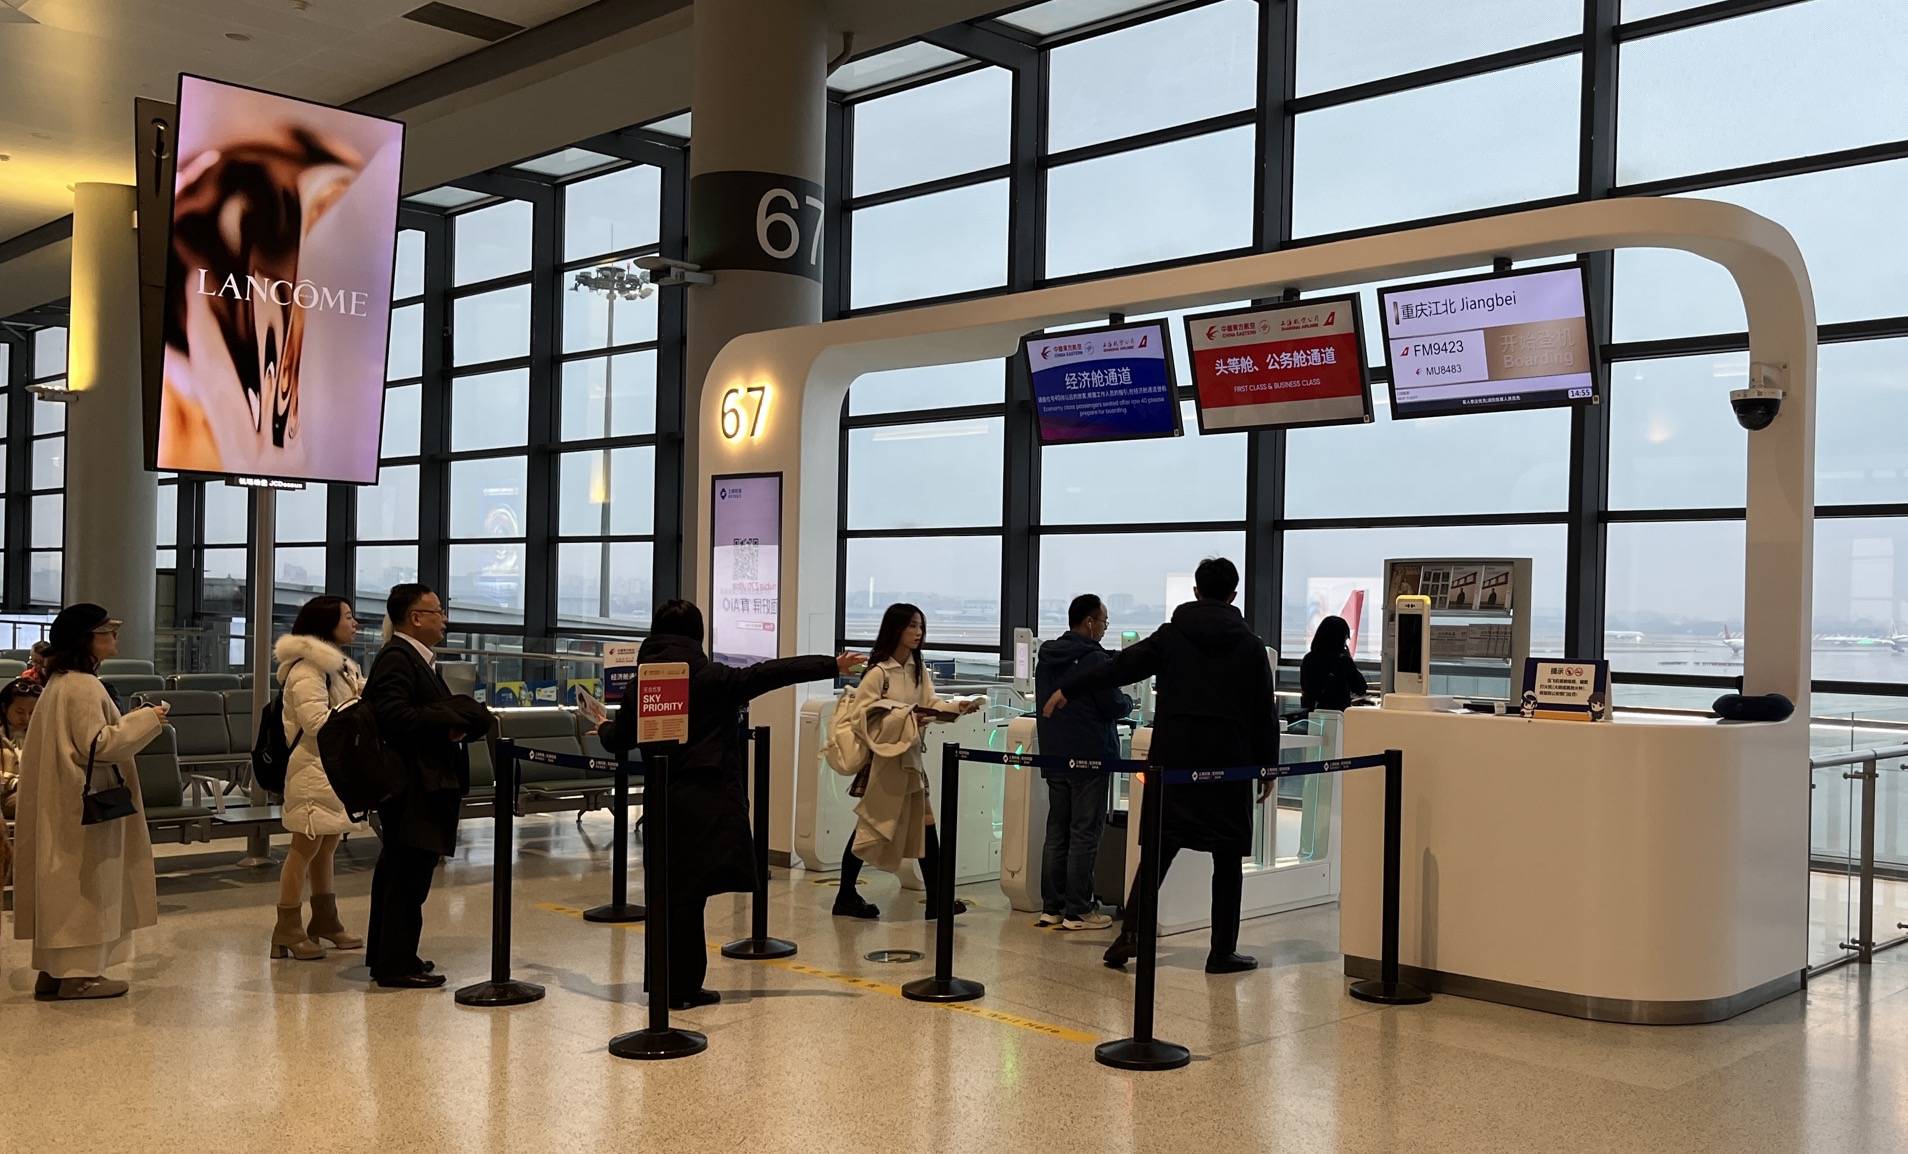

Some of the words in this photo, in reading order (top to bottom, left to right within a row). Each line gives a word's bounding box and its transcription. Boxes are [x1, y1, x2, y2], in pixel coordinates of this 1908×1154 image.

[756, 188, 824, 265] 67
[197, 268, 369, 317] LANCÔME
[1401, 298, 1456, 320] 重庆江北
[1460, 291, 1517, 312] Jiangbei
[1413, 340, 1464, 357] FM9423
[1501, 328, 1574, 352] 开始登机
[1503, 351, 1574, 369] Boarding
[1064, 366, 1133, 390] 经济舱通道
[1426, 364, 1462, 376] MU8483
[1234, 385, 1249, 393] FIRST
[1249, 383, 1267, 392] CLASS
[1273, 380, 1301, 390] BUSINESS
[1301, 378, 1321, 387] CLASS
[1570, 388, 1591, 398] 14:55
[721, 386, 765, 438] 67
[643, 694, 661, 704] SKY
[643, 702, 683, 713] PRIORITY
